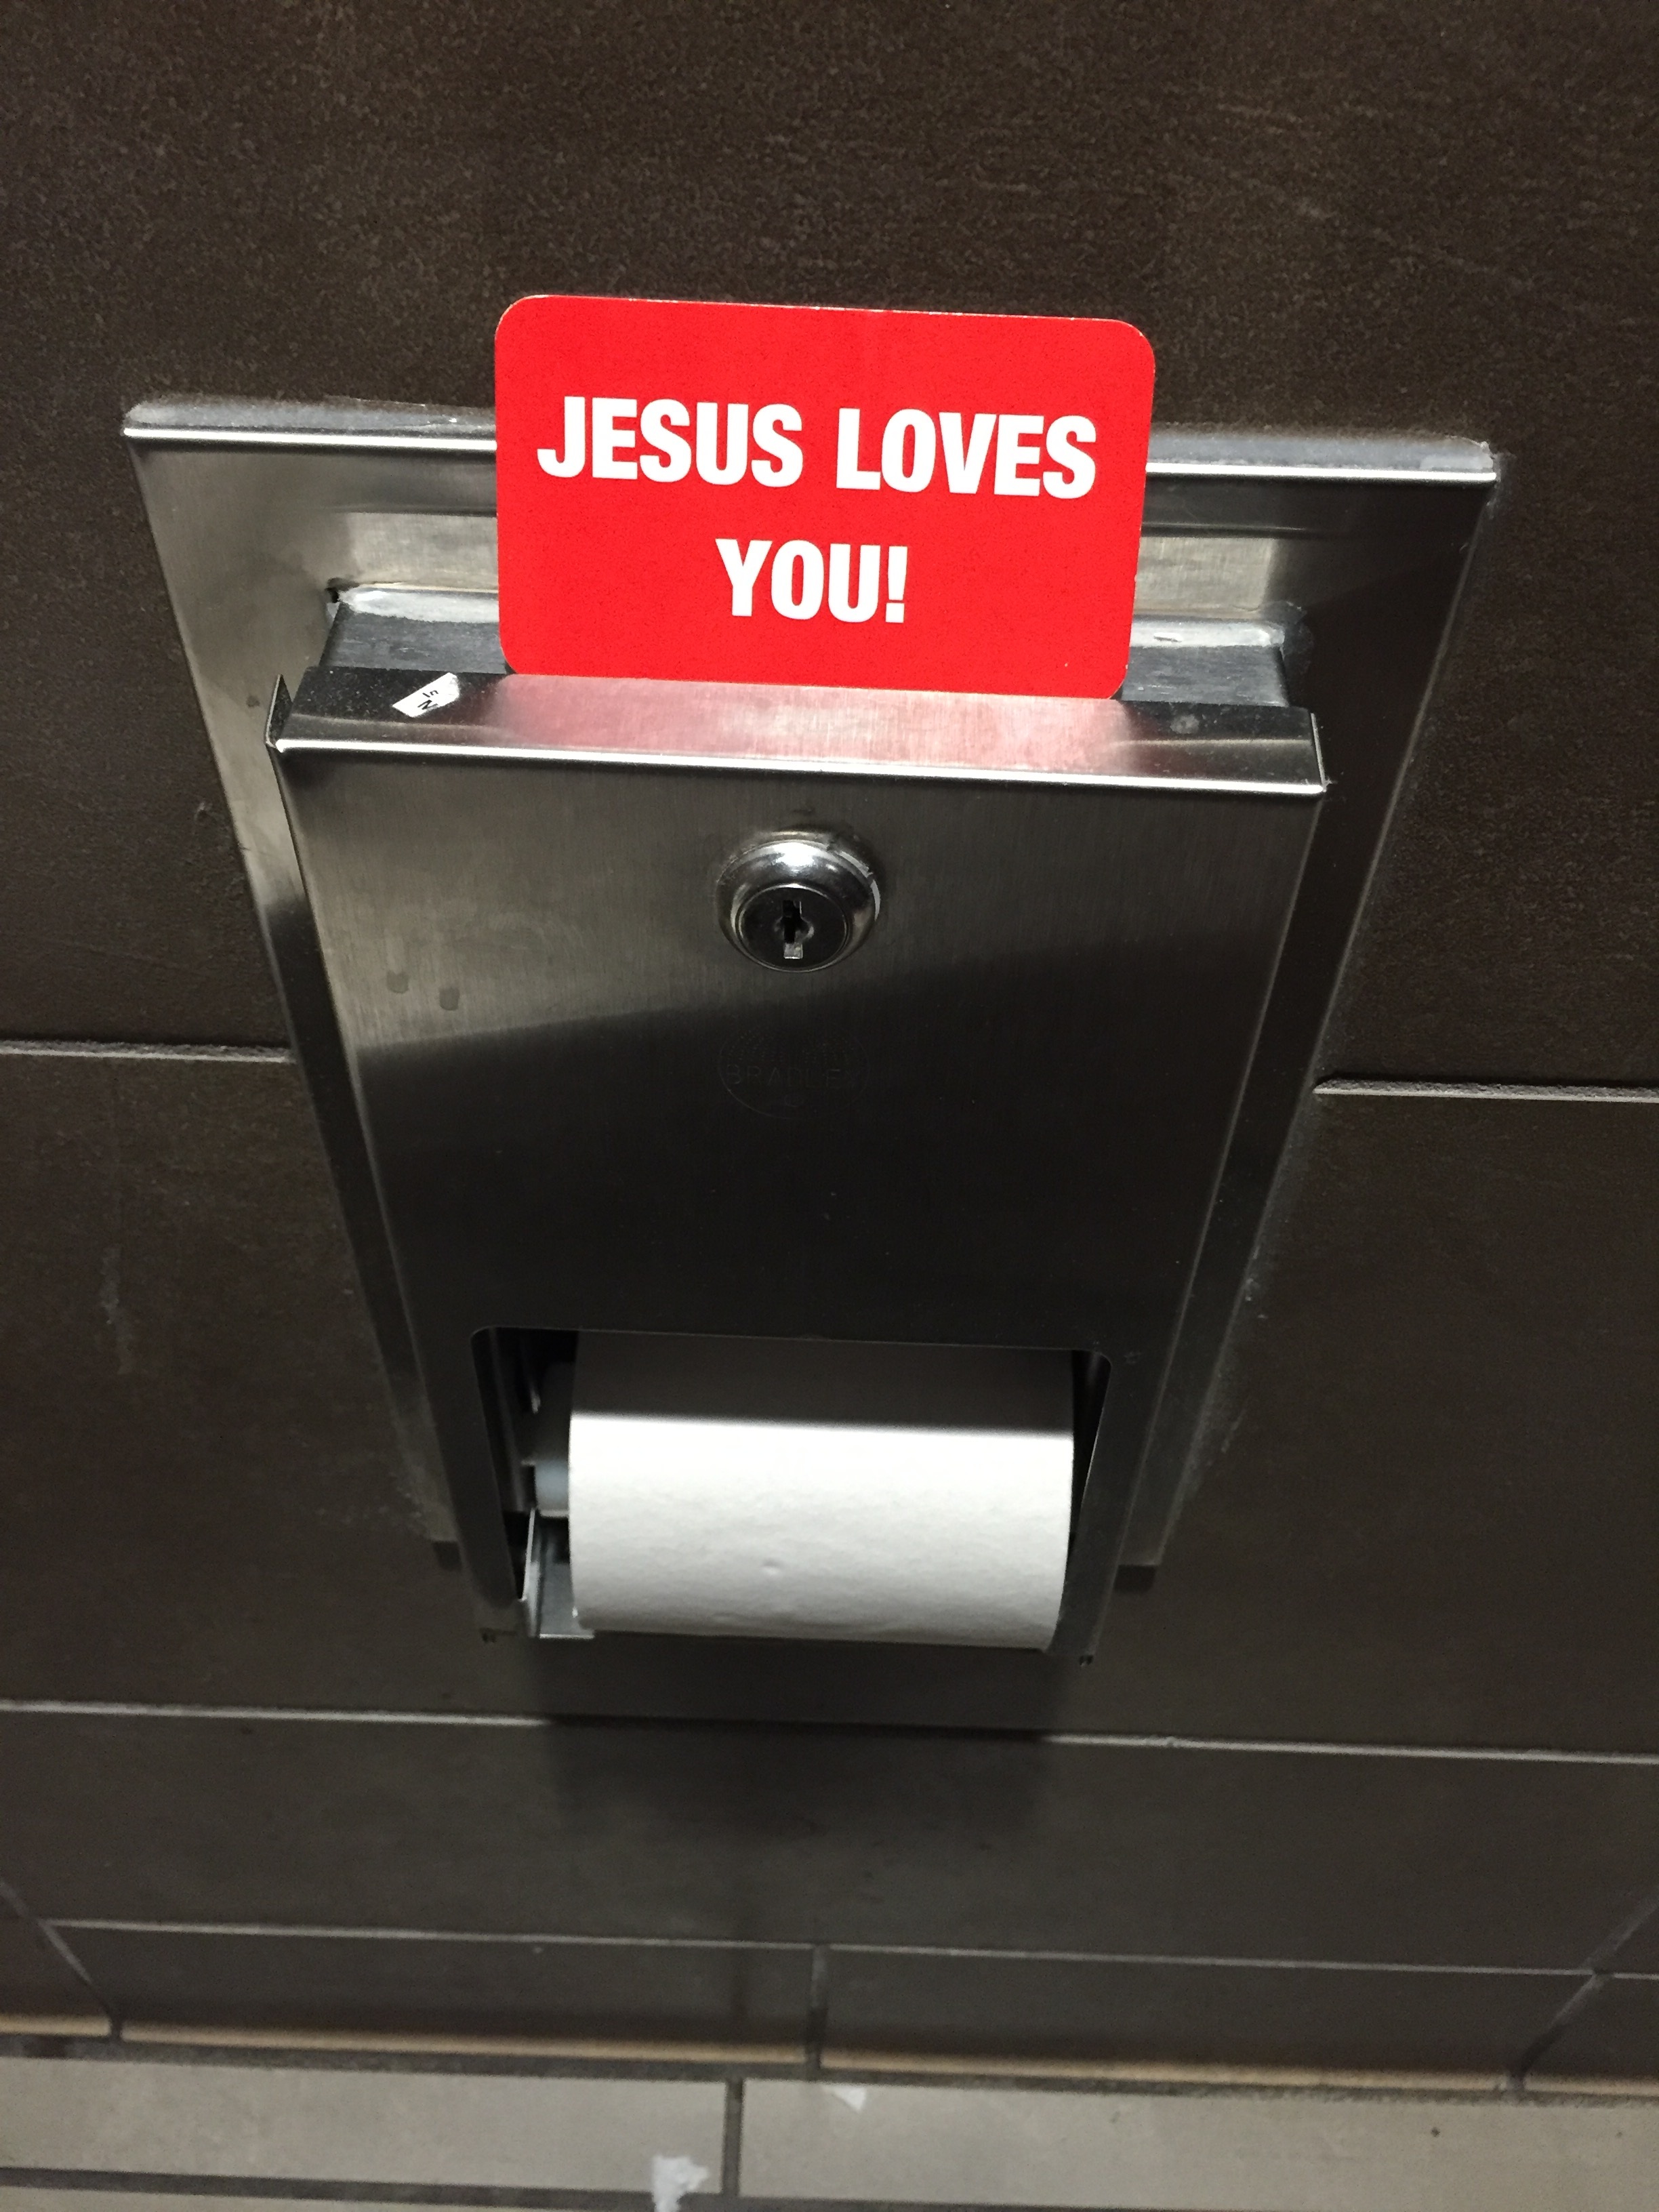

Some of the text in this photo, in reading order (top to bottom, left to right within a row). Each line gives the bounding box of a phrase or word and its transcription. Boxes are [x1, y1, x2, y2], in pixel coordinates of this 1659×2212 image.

[537, 396, 1097, 499] JESUS LOVES
[715, 538, 908, 623] YOU!
